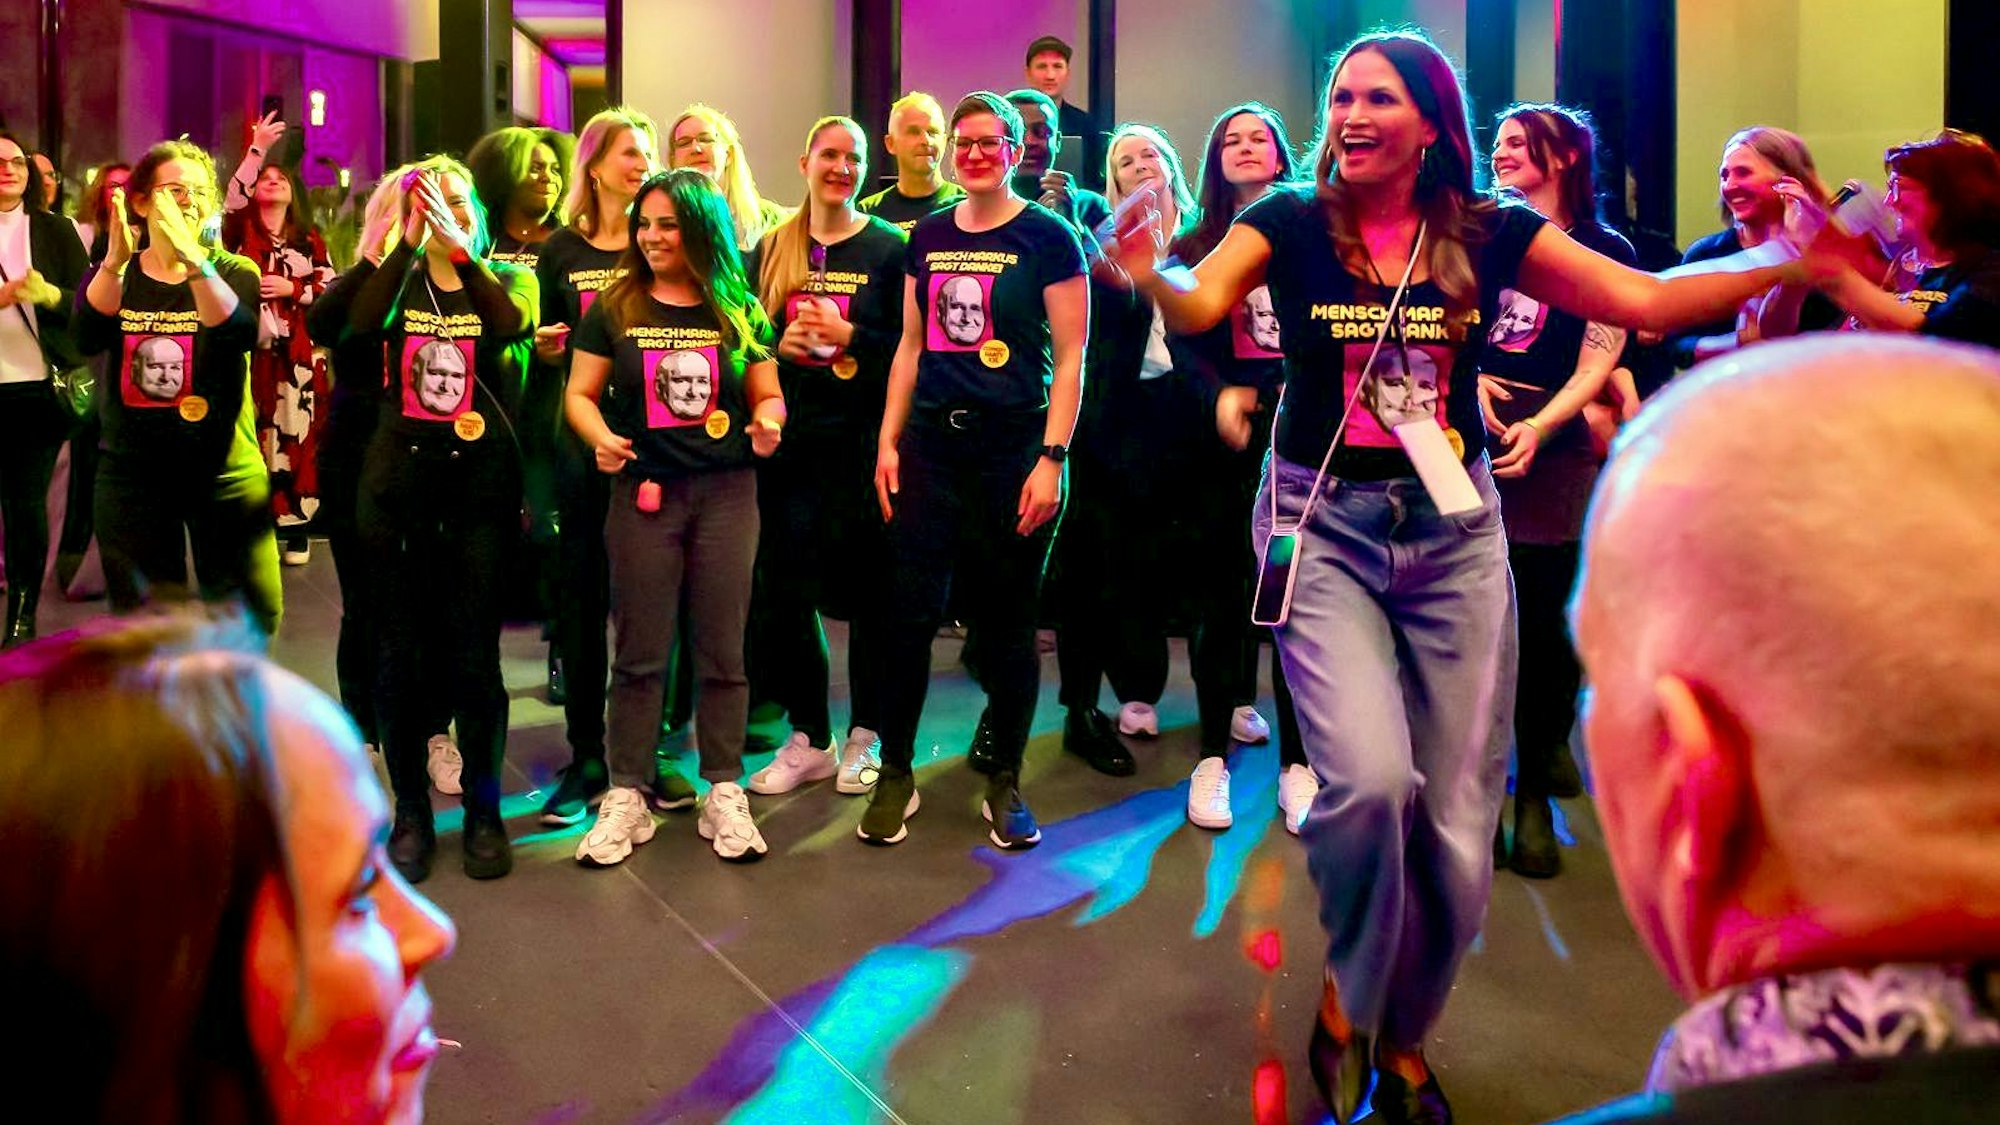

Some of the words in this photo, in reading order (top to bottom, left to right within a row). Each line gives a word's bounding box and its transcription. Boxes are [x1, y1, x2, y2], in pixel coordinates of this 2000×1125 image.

[926, 251, 968, 262] MENSCH
[968, 251, 1018, 265] MARKUS
[929, 262, 960, 271] SAGT
[160, 311, 200, 322] MARKU
[121, 321, 152, 332] SAGT
[625, 327, 679, 338] MENSCH
[637, 338, 673, 349] SAGT
